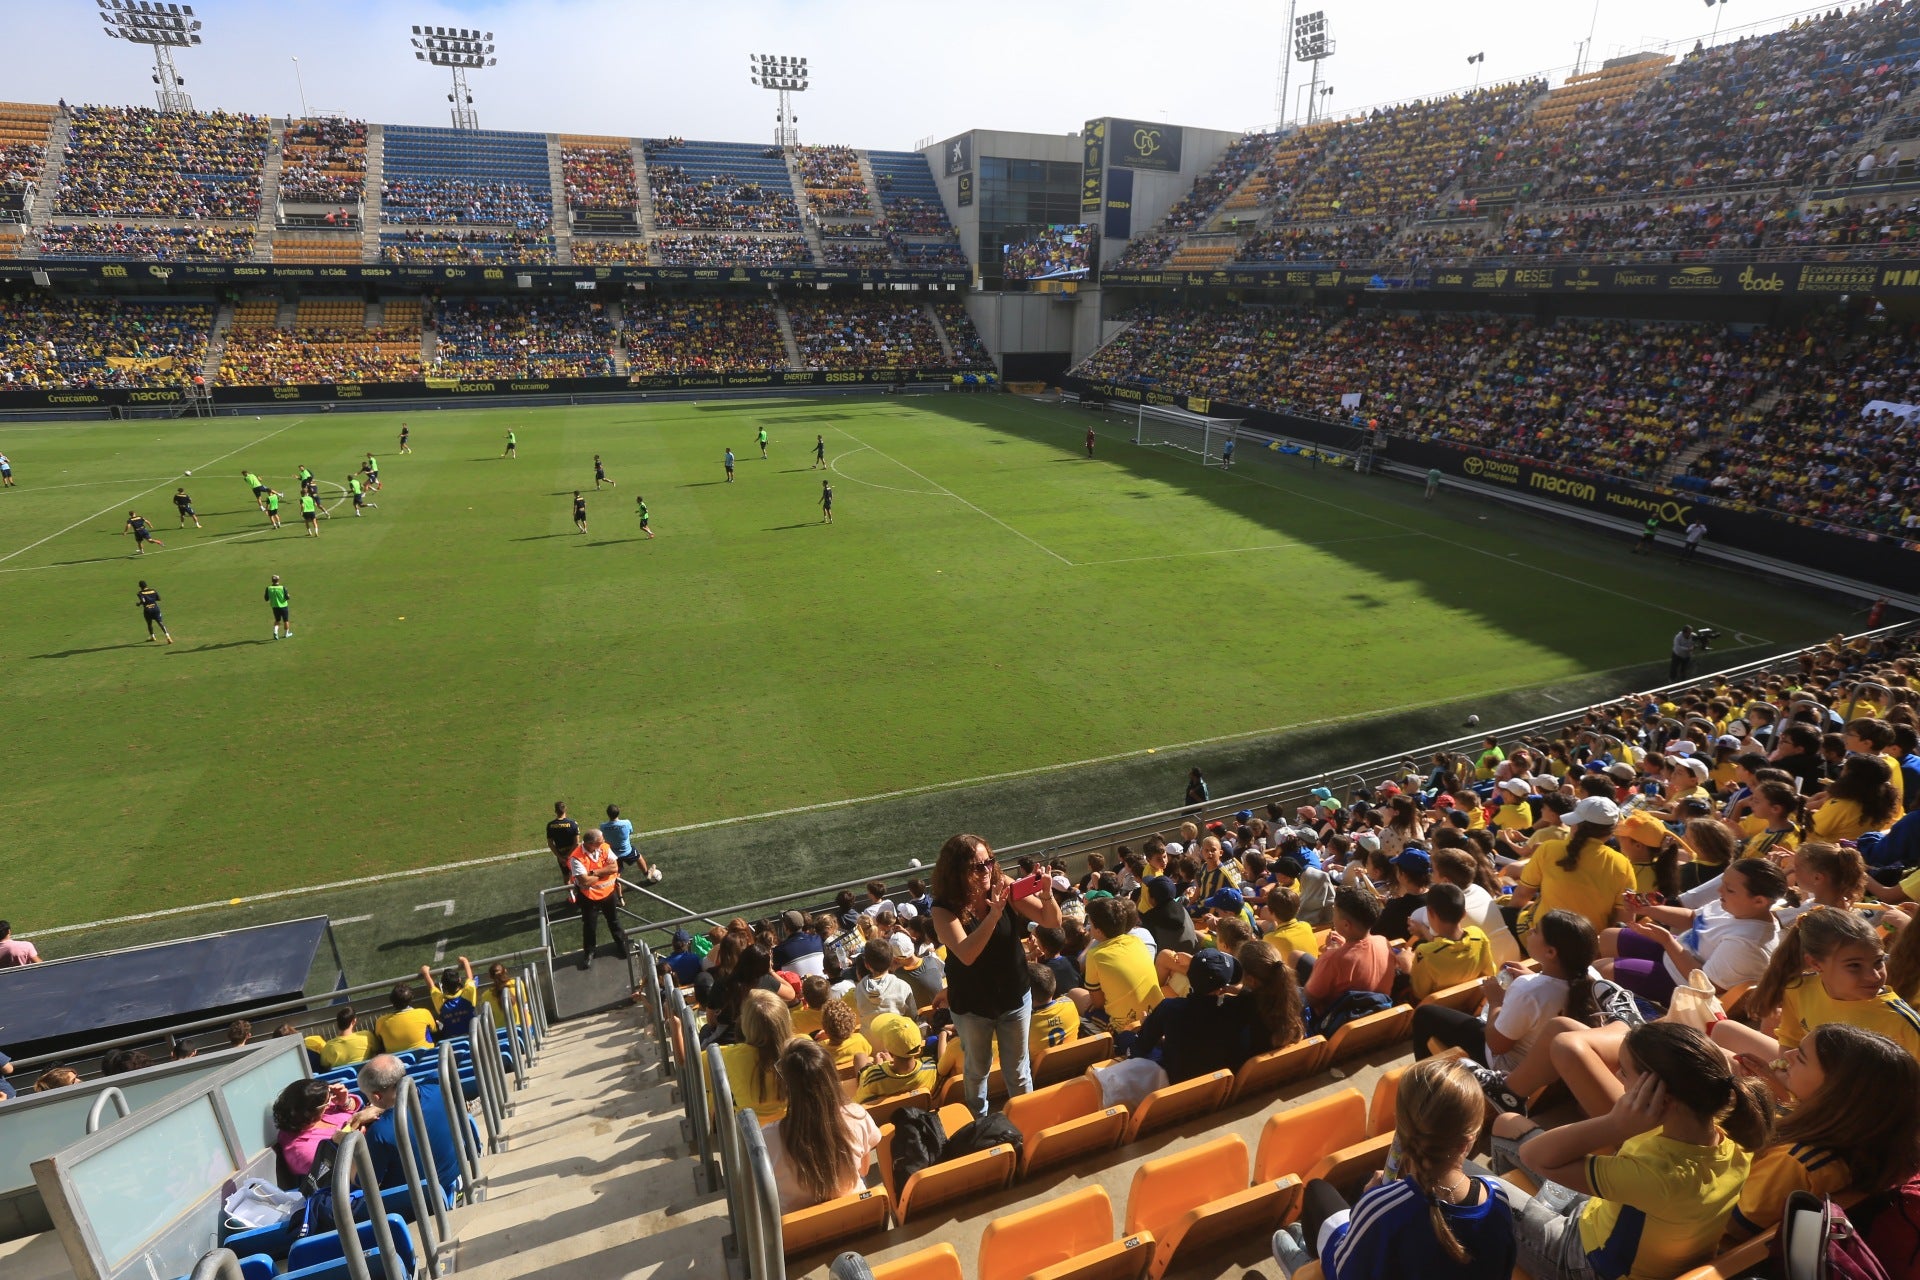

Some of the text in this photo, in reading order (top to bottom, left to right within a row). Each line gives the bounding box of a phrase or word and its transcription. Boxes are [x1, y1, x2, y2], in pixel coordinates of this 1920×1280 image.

[233, 267, 259, 275] asisa
[273, 268, 314, 277] Ayuntamiento
[329, 268, 347, 276] Cádiz
[455, 269, 466, 277] bp
[1809, 265, 1878, 274] CONFEDERACIÓN
[1514, 269, 1556, 283] RESET
[1669, 276, 1722, 285] COHEBU
[1807, 274, 1876, 283] EMPRESAS
[825, 372, 856, 382] asisa
[511, 383, 550, 391] Cruzcampo
[1114, 387, 1142, 401] macron
[48, 394, 99, 405] Cruzcampo
[1485, 459, 1520, 476] TOYOTA
[1529, 471, 1597, 501] macron
